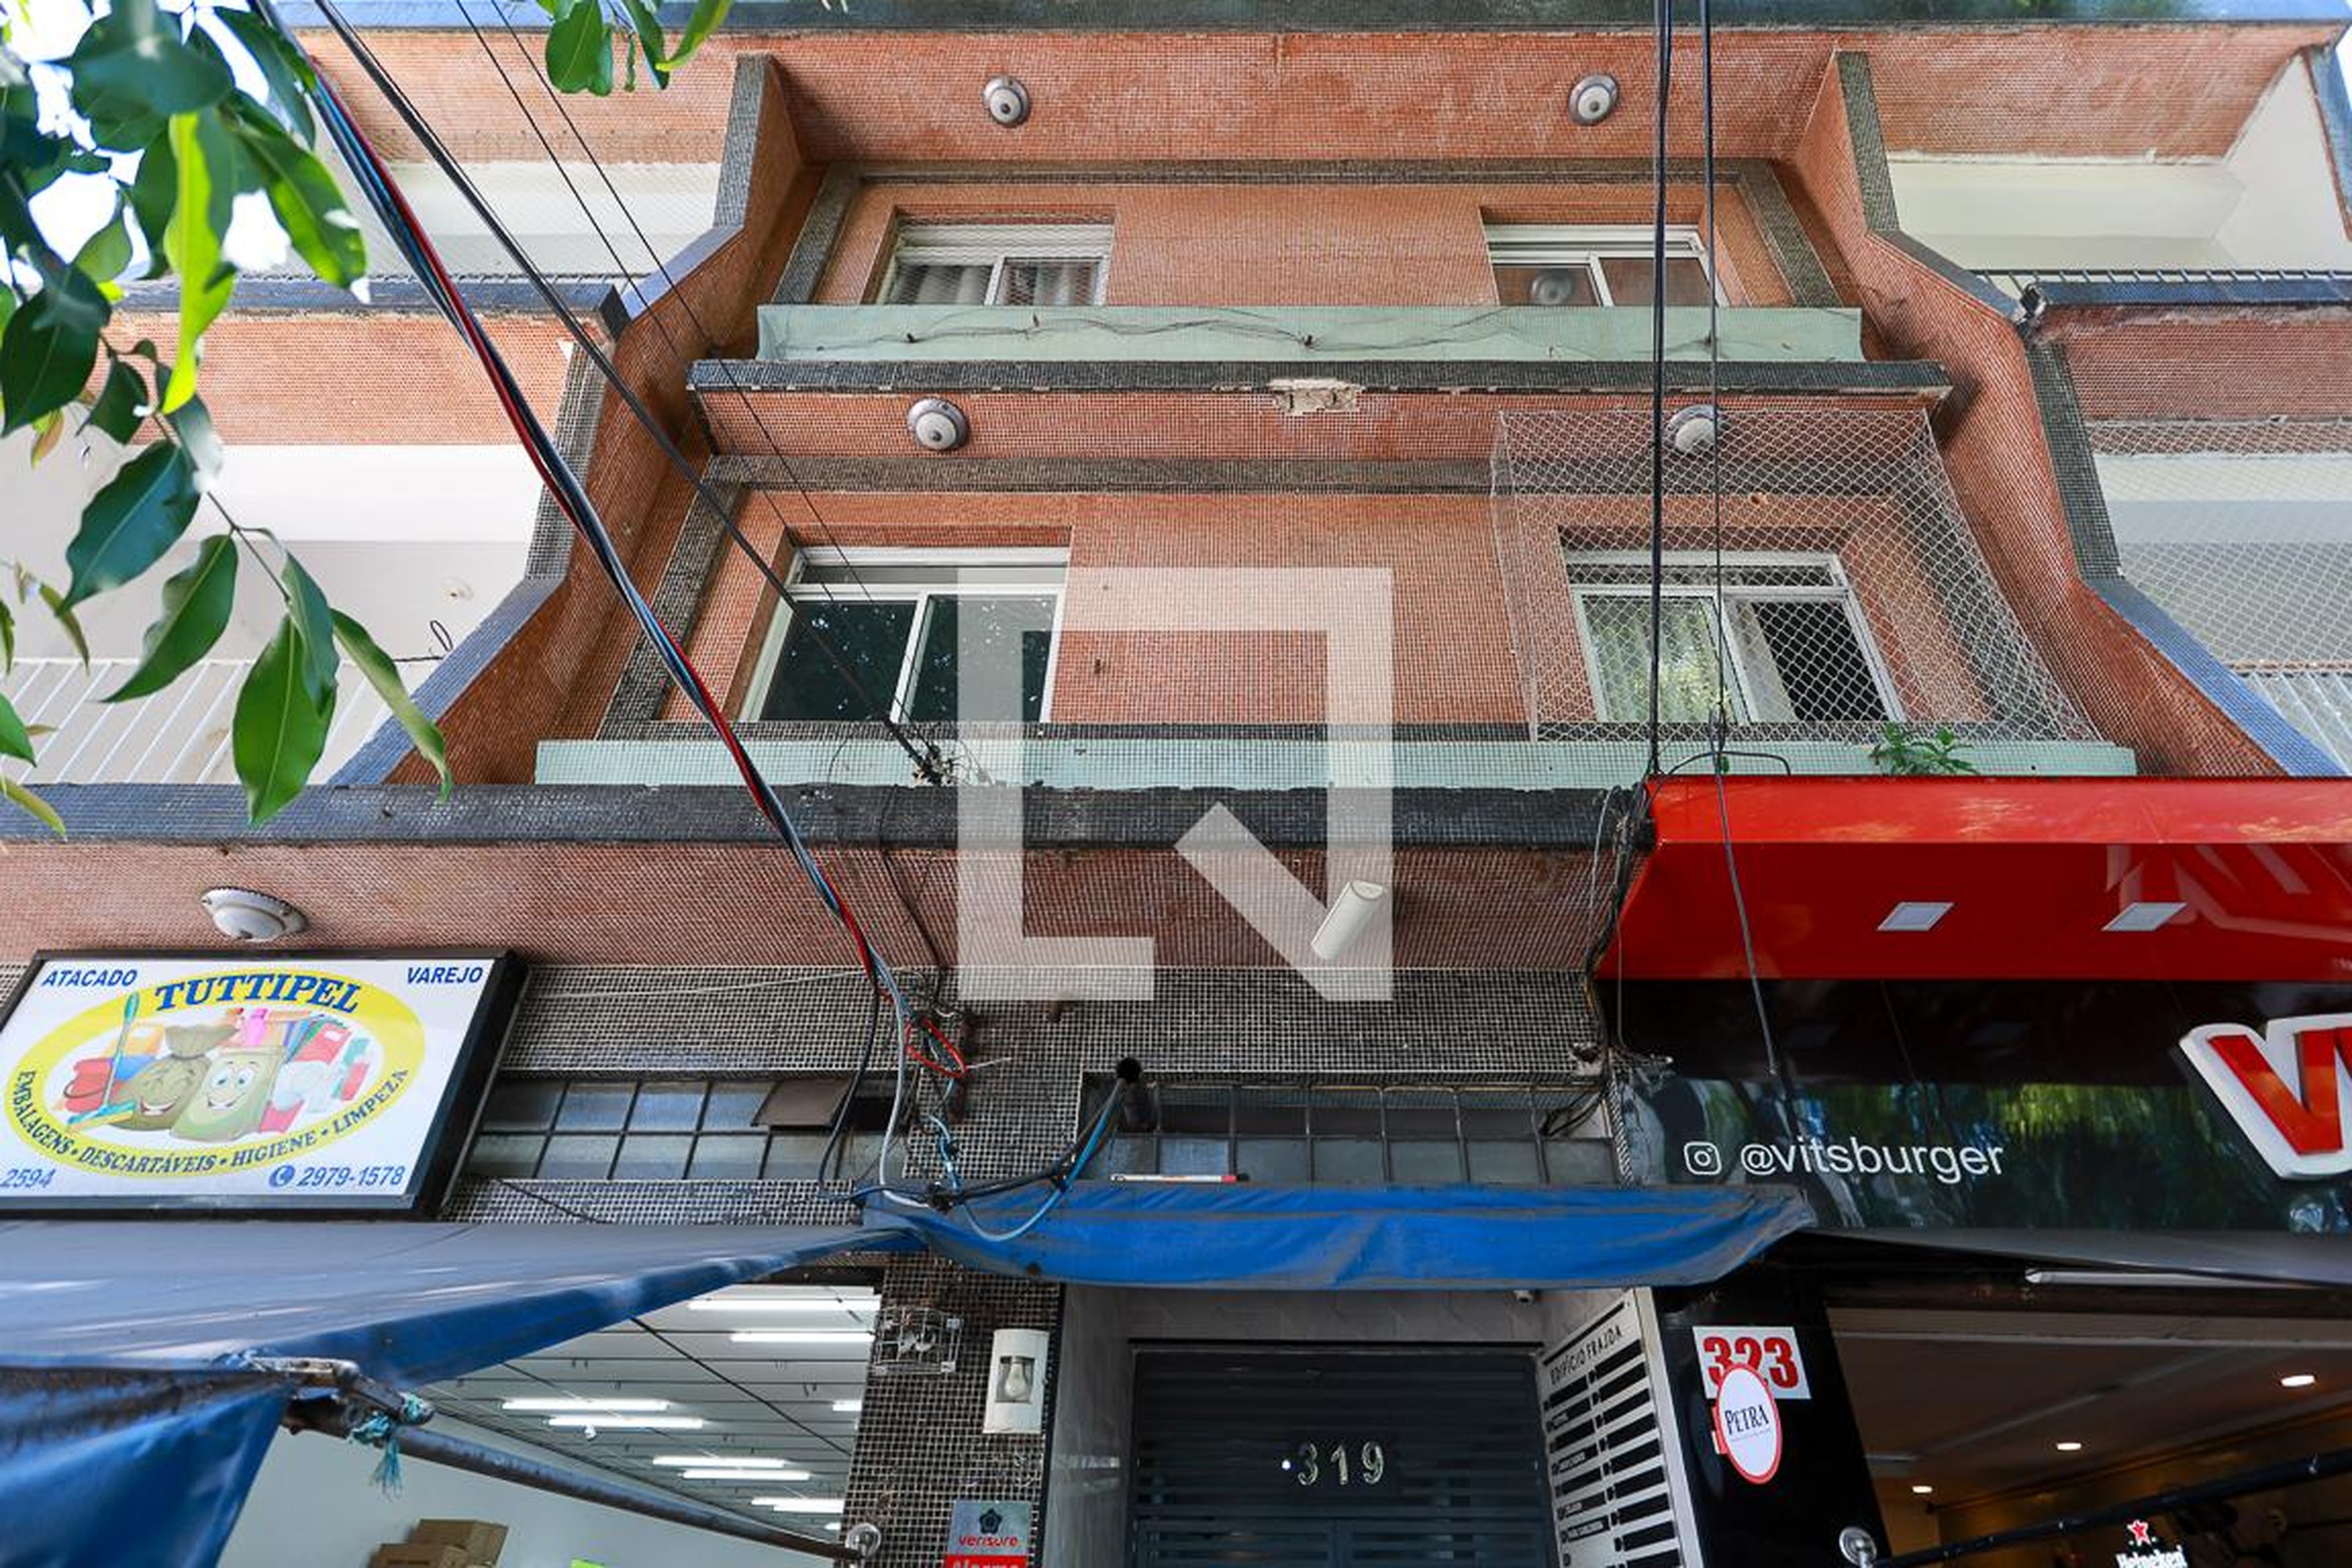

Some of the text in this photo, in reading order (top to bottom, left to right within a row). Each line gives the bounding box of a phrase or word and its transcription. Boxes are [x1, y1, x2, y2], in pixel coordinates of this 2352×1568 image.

[41, 970, 137, 986] ATACADO
[155, 973, 361, 1013] TUTTIPEL
[407, 967, 483, 984] VAREJO
[13, 1069, 409, 1173] EMBALAGENS DESCARTÁVEIS HIGIENE LIMPEZA
[297, 1166, 405, 1186] 2979-1578
[1741, 1137, 2003, 1184] @vitsburger
[1703, 1336, 1799, 1389] 323
[1724, 1404, 1769, 1435] PETRA
[1298, 1442, 1384, 1485] 319
[959, 1534, 1019, 1547] verisure
